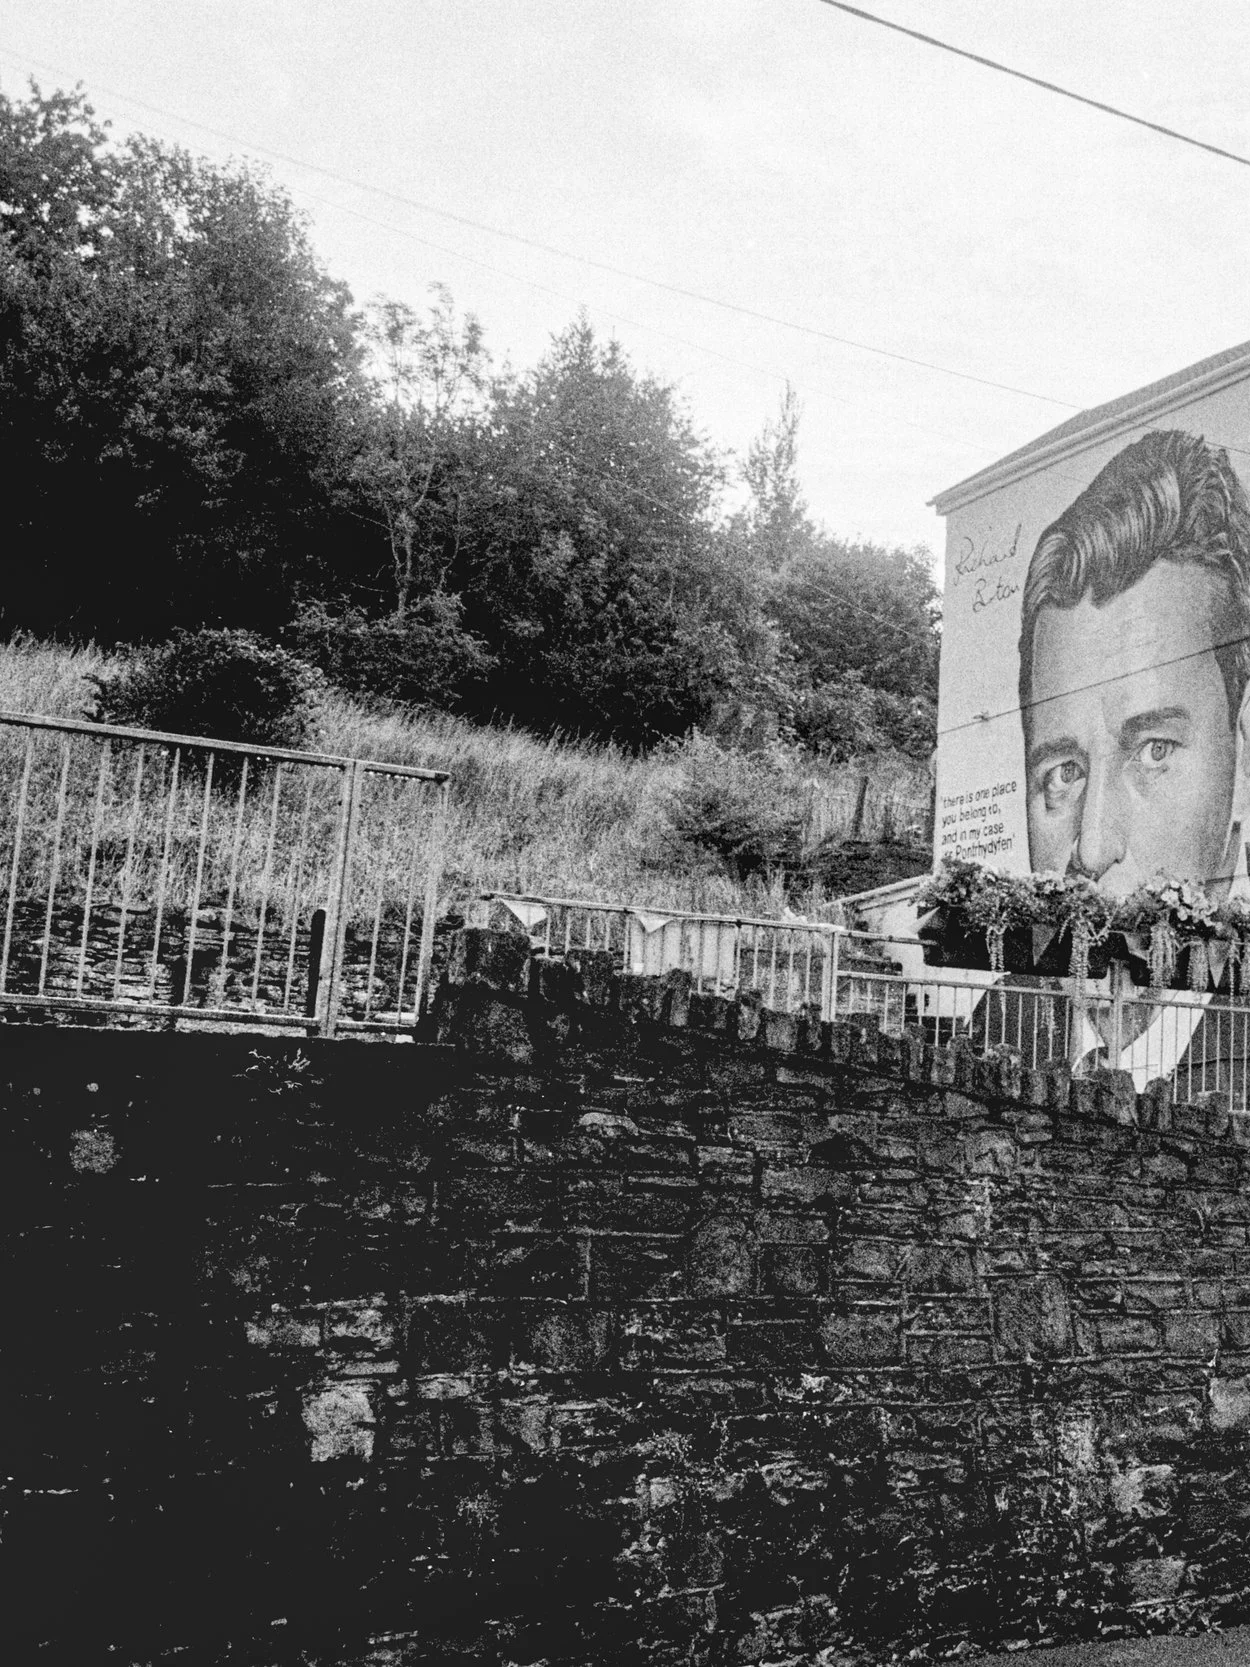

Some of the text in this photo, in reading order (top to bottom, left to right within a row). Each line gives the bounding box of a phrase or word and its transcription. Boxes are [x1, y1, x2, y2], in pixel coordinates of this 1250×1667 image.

[966, 790, 974, 803] is
[975, 788, 990, 802] one
[992, 780, 1017, 801] place
[942, 814, 956, 829] you
[960, 806, 986, 823] belong
[941, 831, 957, 845] and
[969, 828, 980, 841] my
[983, 822, 1004, 837] case
